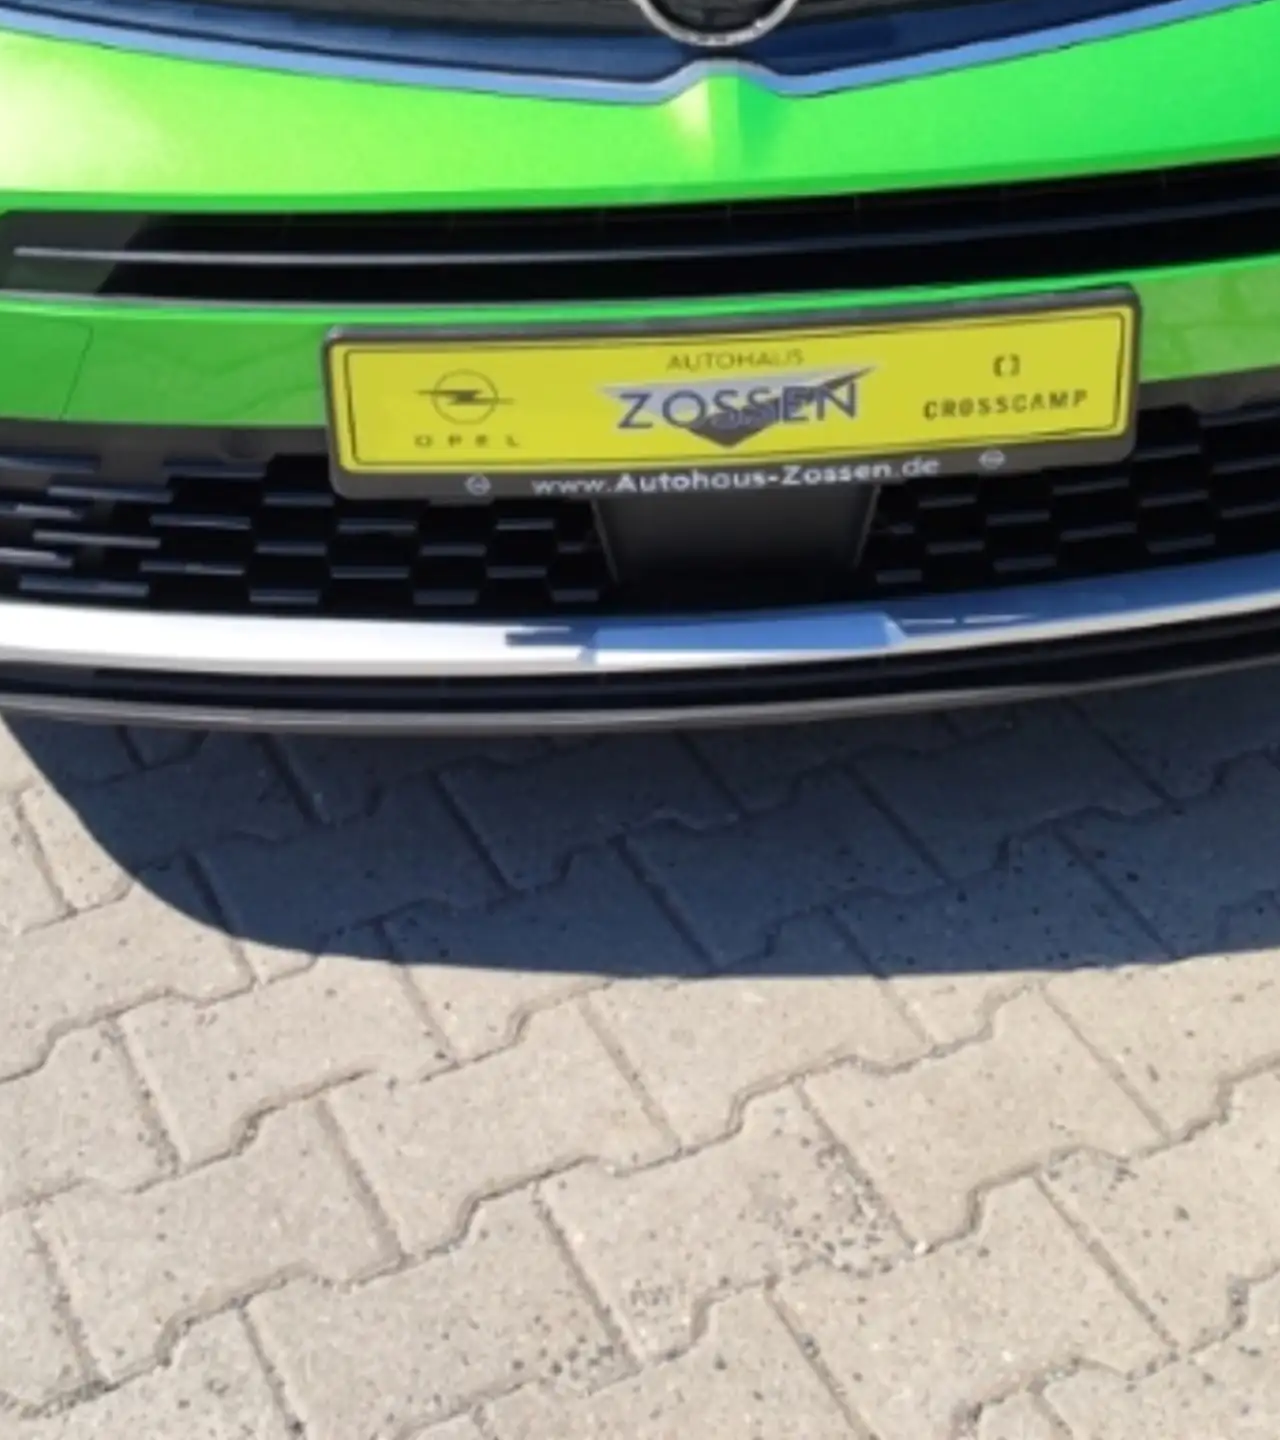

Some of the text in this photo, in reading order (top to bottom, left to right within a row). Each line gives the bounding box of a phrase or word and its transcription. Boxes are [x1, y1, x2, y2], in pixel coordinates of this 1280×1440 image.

[667, 349, 805, 371] AUTOHAUS
[617, 382, 858, 431] ZOSSEN
[923, 389, 1089, 421] CROSSCAMP
[414, 434, 520, 448] OPEL
[532, 456, 940, 494] www.Autohaus-Zossen.de
